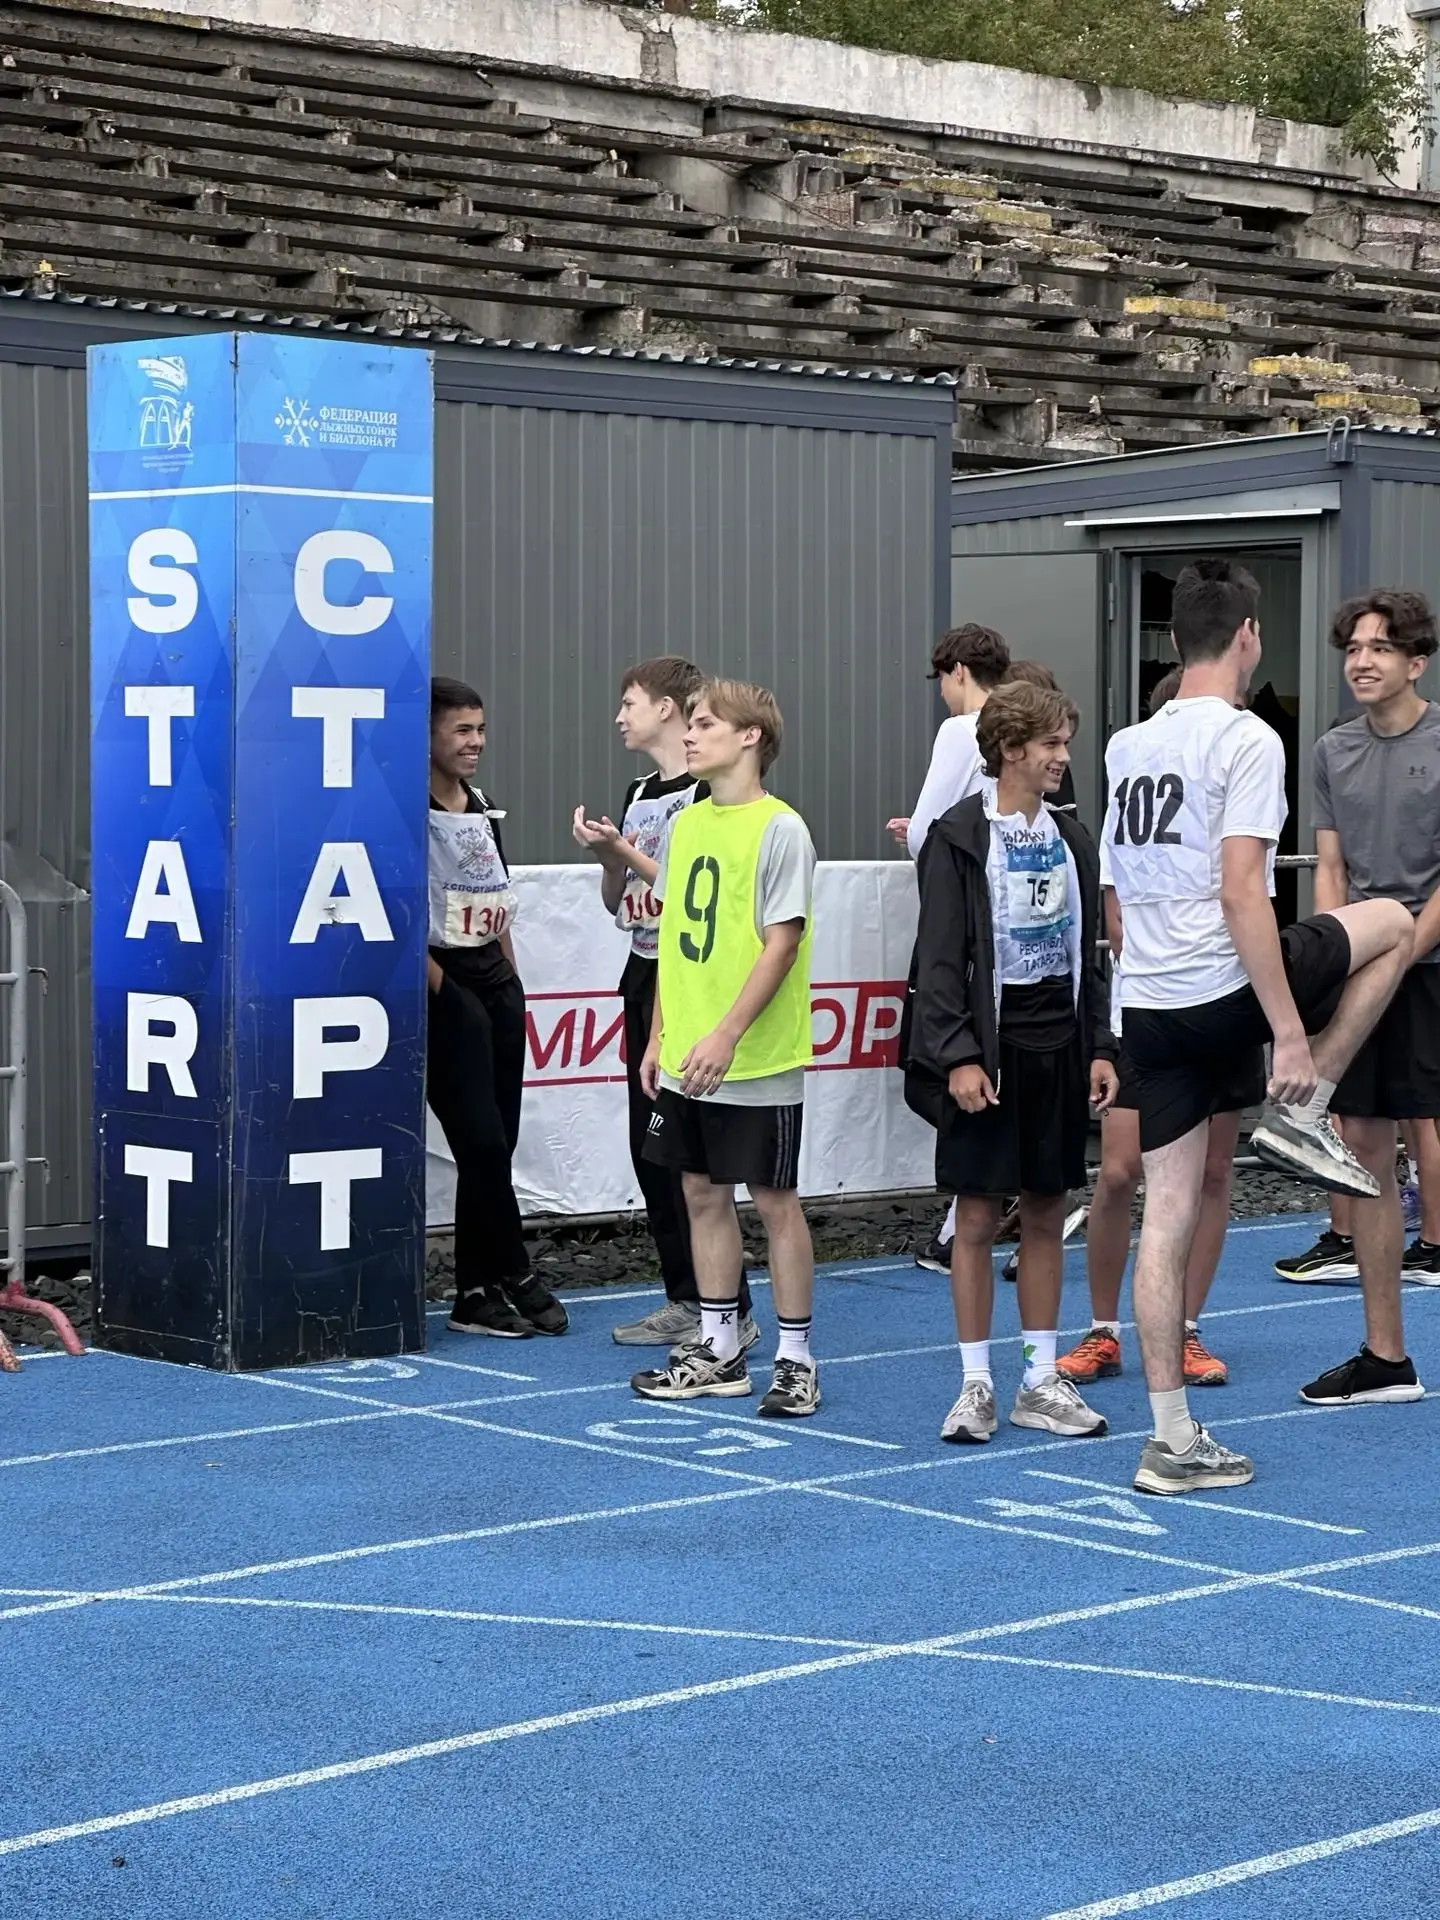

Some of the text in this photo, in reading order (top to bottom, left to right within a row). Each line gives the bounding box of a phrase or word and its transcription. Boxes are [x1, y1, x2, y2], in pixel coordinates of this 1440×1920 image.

[319, 406, 398, 425] ФЕДЕРАЦИЯ
[319, 421, 397, 437] ЛЫЖНЫХ ГОНОК
[319, 432, 397, 448] И БИАТЛОНА РТ
[1114, 773, 1184, 846] 102
[125, 528, 202, 1248] START
[289, 530, 395, 1251] СТАРТ
[1027, 878, 1050, 907] 75
[461, 906, 506, 937] 130
[680, 855, 720, 964] 9
[720, 1312, 733, 1325] K
[585, 1418, 793, 1456] 5
[974, 1495, 1168, 1536] 4
